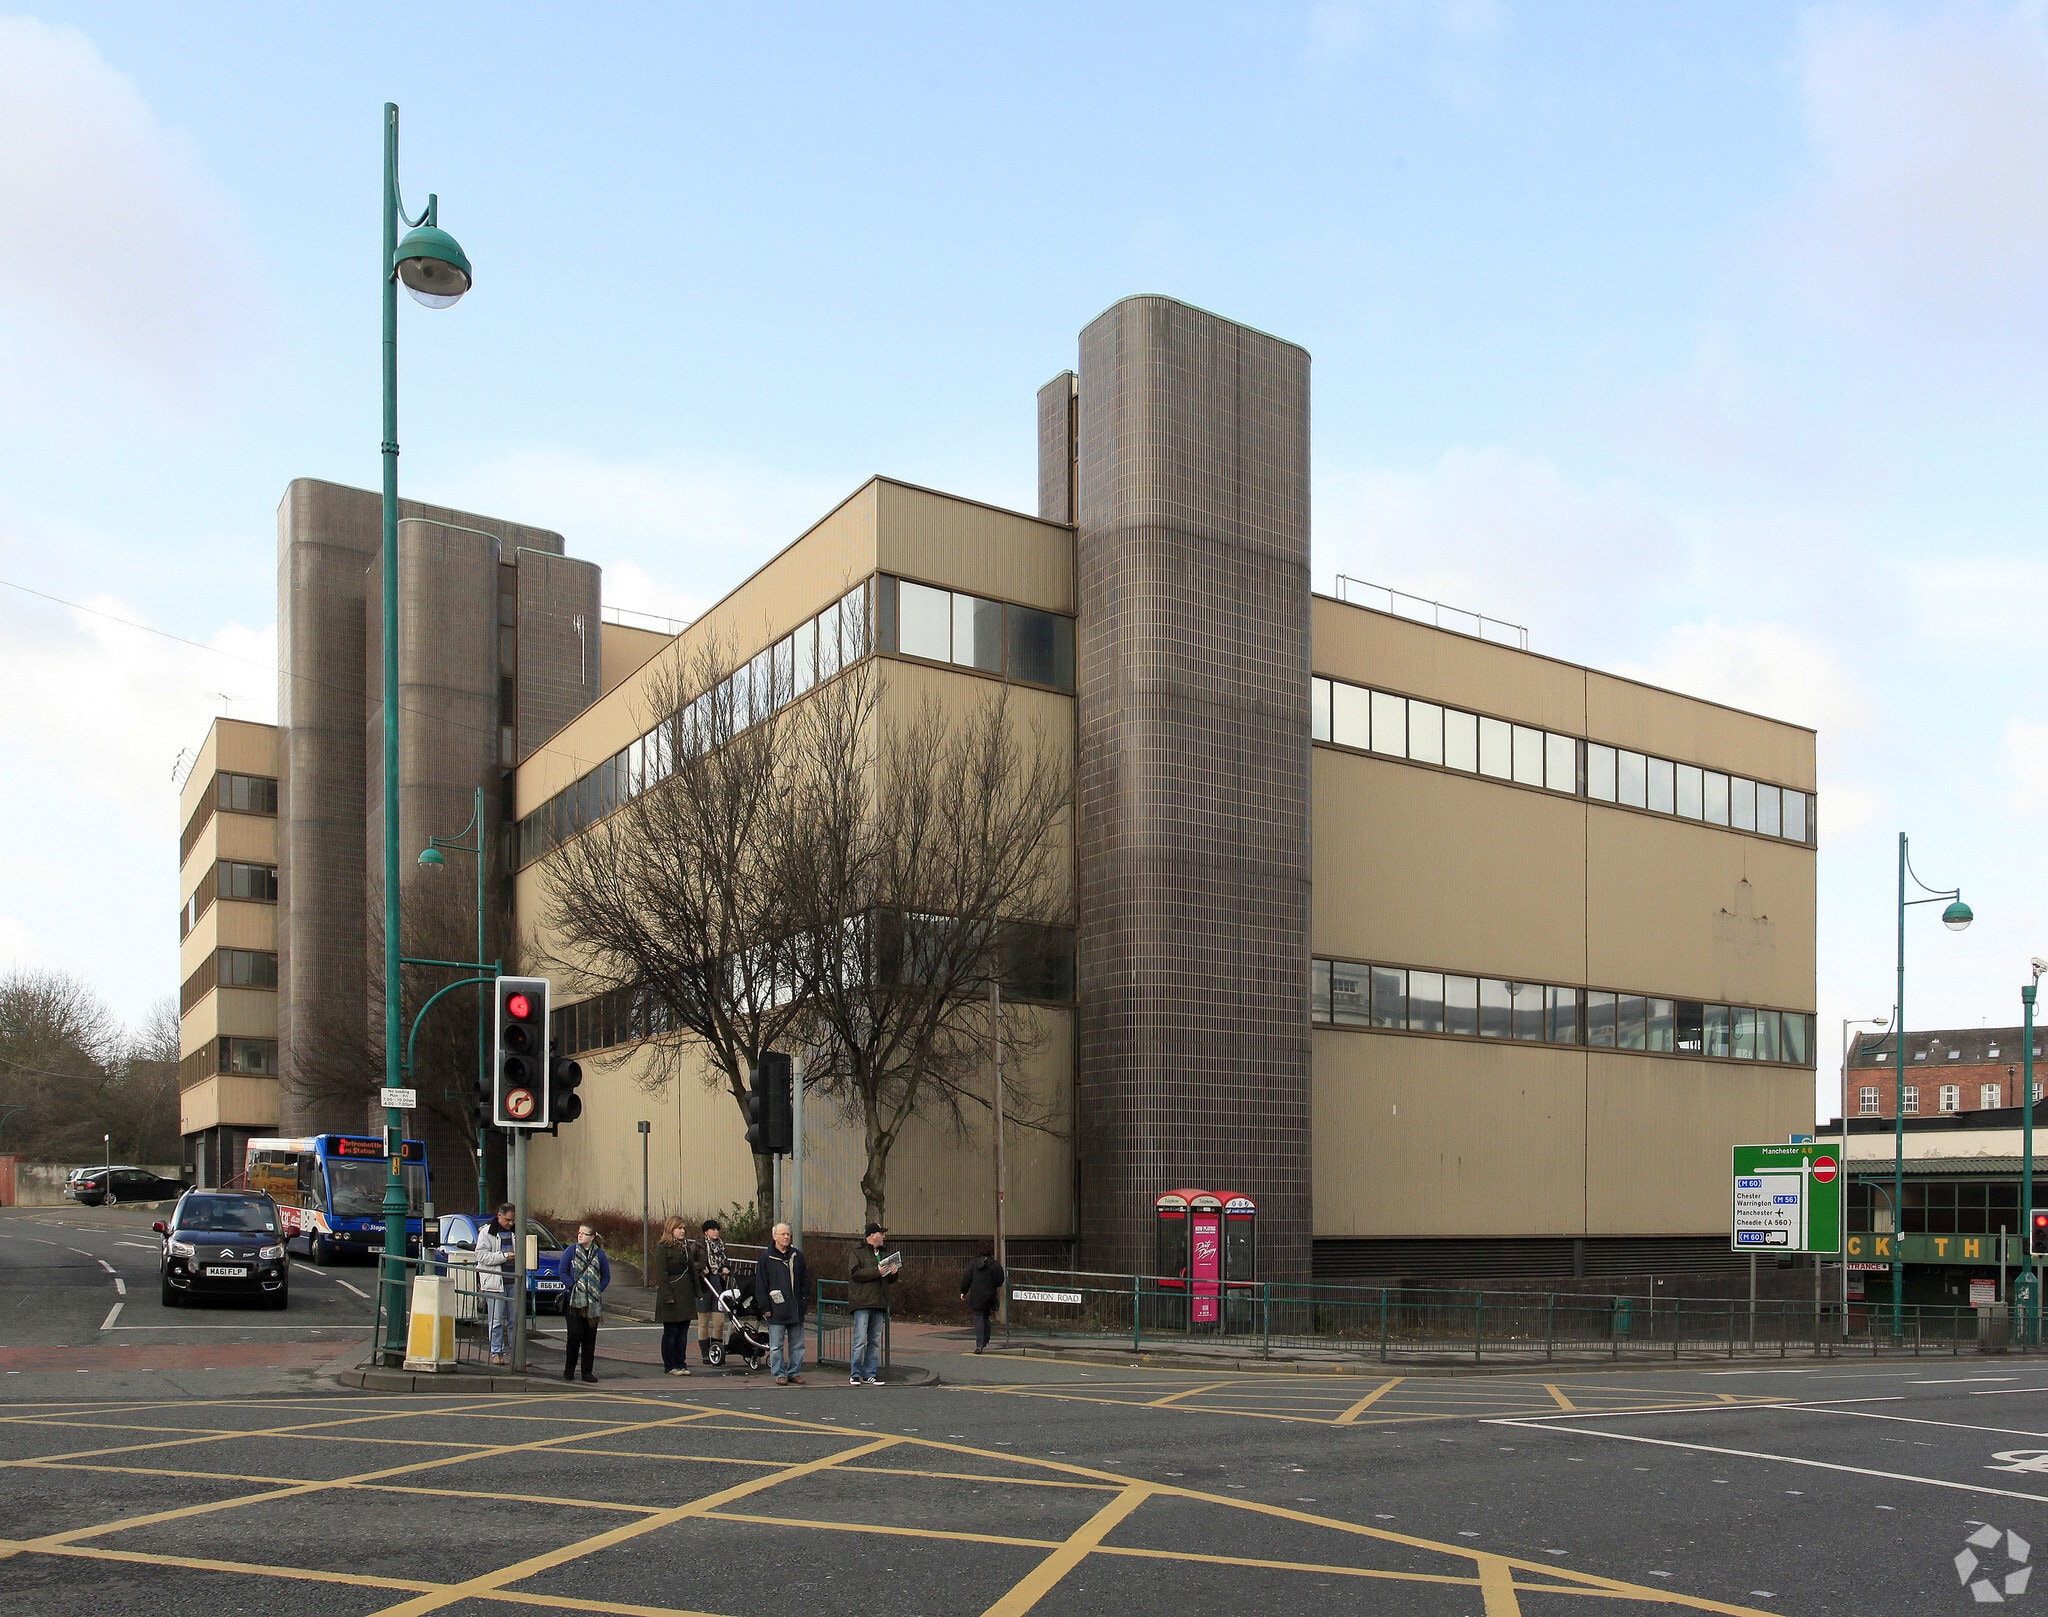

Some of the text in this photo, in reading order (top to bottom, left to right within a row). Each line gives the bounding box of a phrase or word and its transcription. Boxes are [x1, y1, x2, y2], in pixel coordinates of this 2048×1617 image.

[1762, 1147, 1799, 1155] Manchester
[1023, 1292, 1079, 1302] STATION ROAD
